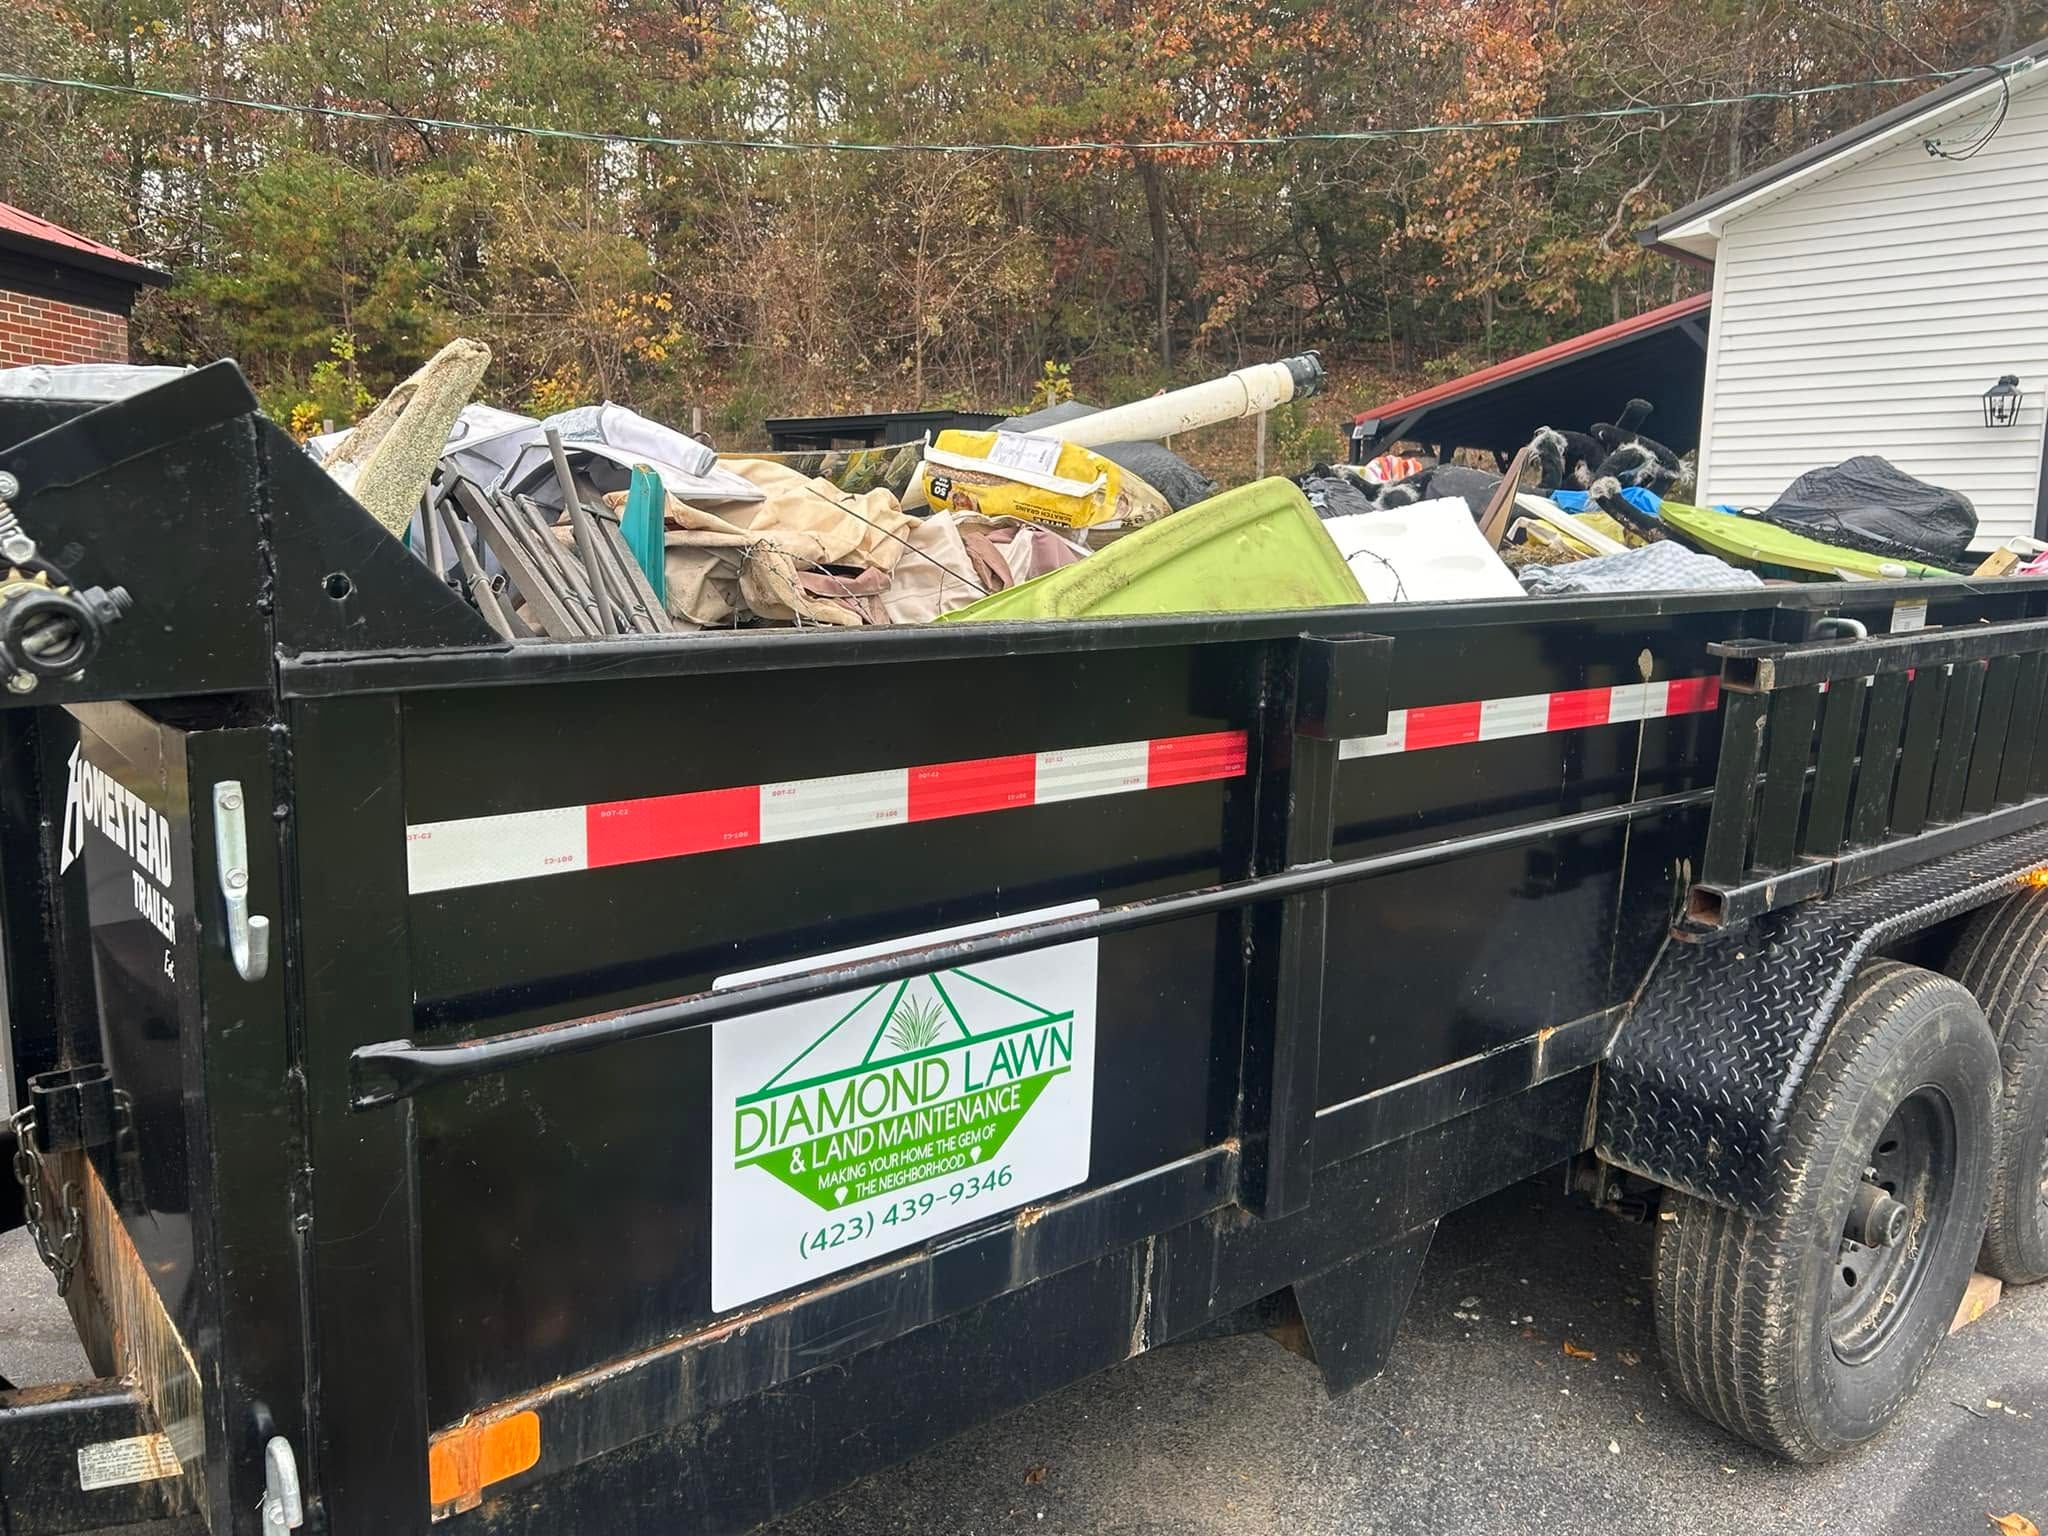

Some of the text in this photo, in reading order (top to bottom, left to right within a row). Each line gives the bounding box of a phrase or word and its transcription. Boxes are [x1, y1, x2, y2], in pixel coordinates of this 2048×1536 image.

[934, 486, 946, 497] 50
[1015, 504, 1040, 516] GRAINS
[60, 740, 173, 889] HOMESTEAD
[600, 808, 629, 818] DOT-C2
[772, 788, 797, 797] DOT-C2
[544, 855, 573, 865] DOT-C2
[132, 869, 177, 946] TRAILER
[735, 1021, 1074, 1157] DIAMOND LAWN
[789, 1083, 1021, 1174] & LAND MAINTENANCE
[818, 1122, 997, 1190] MAKING YOUR HOME THE GEM OF
[855, 1153, 966, 1199] THE NEIGHBORHOOD
[799, 1164, 1014, 1260] (423) 439-9346
